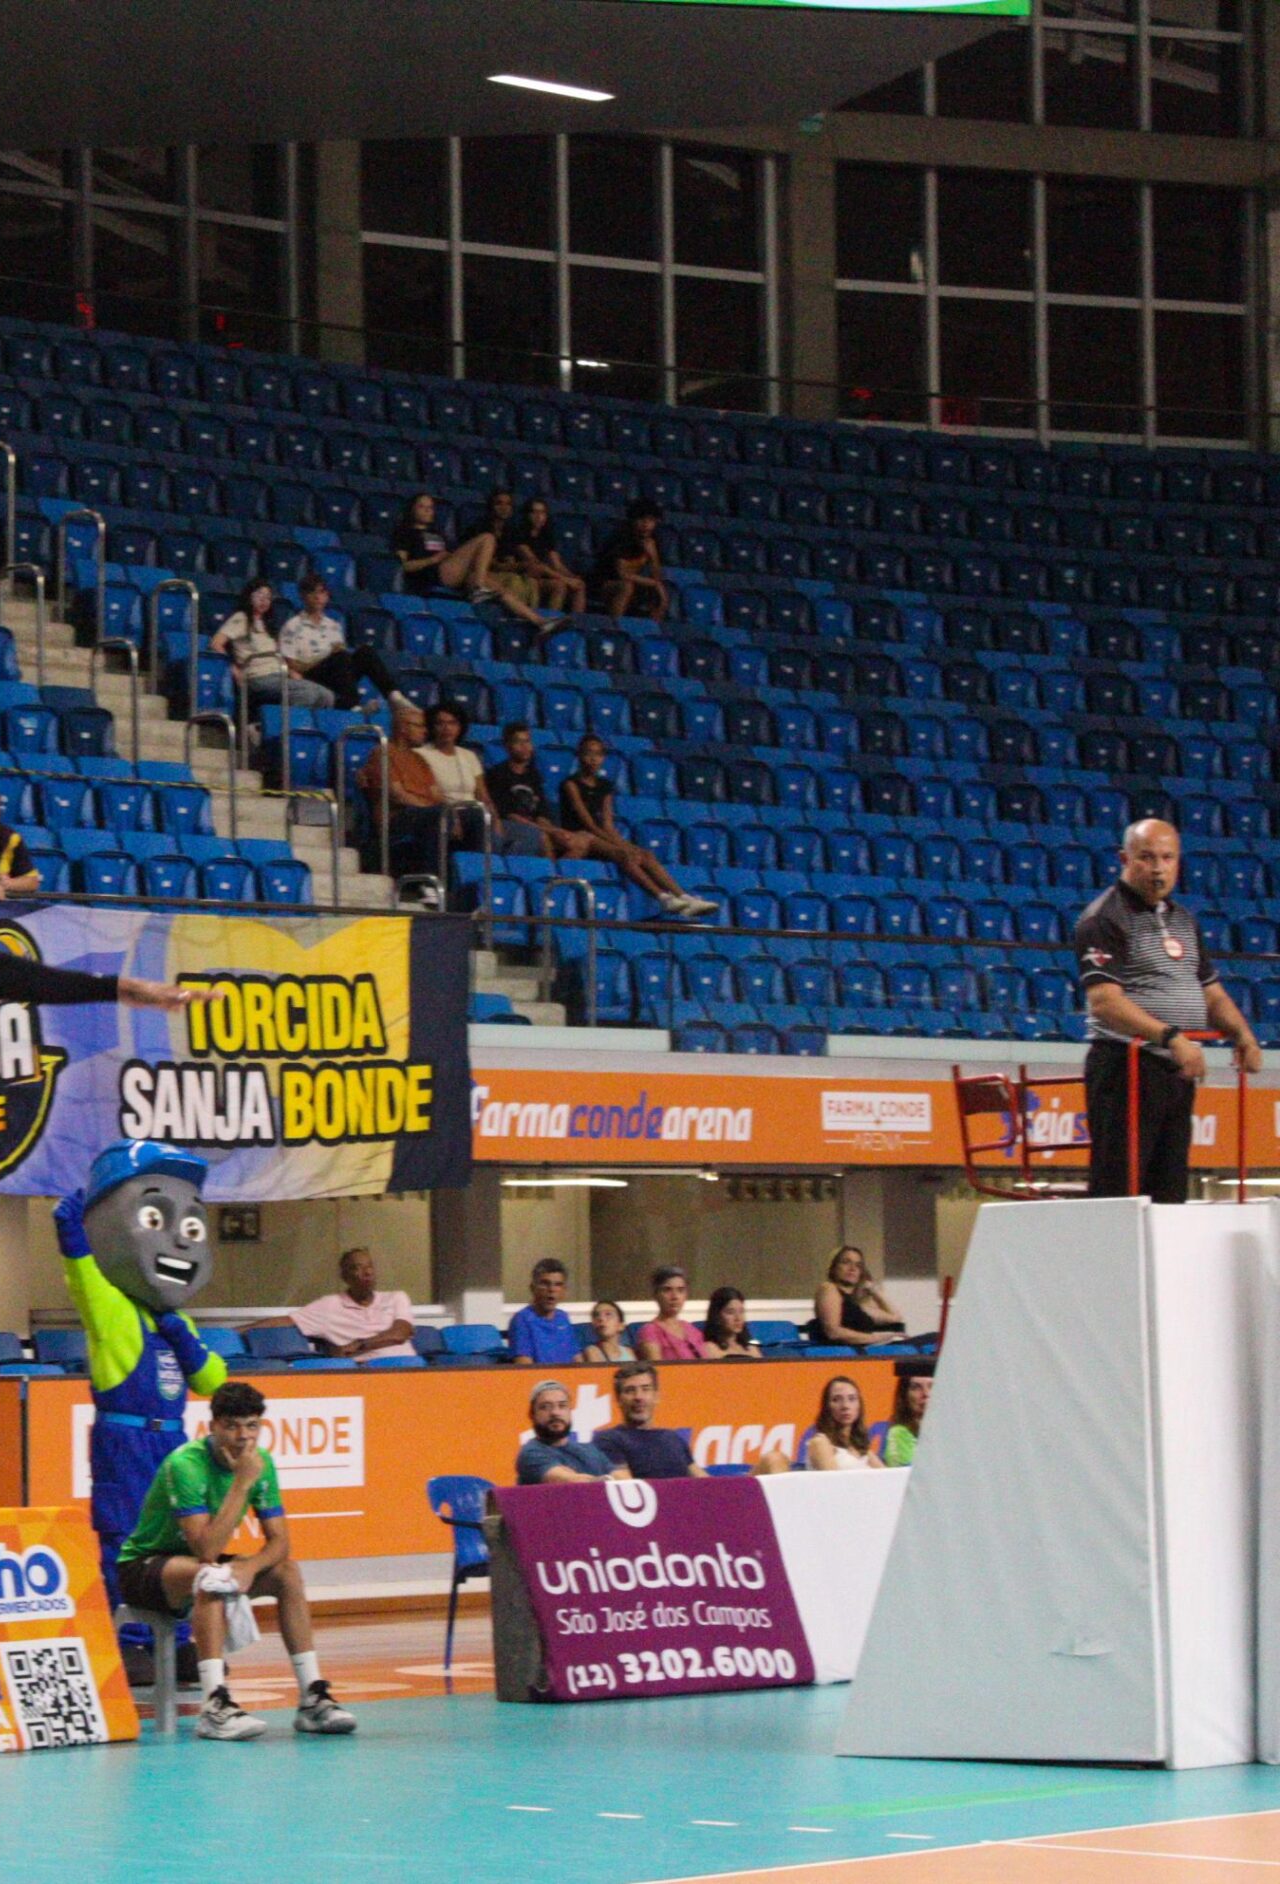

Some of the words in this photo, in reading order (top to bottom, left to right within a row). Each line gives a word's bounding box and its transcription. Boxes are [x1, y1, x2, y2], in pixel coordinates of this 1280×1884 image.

[178, 980, 386, 1052] TORCIDA
[122, 1066, 274, 1140] SANJA
[282, 1064, 433, 1140] BONDE
[827, 1099, 873, 1114] FARMA
[880, 1101, 926, 1117] CONDE
[536, 1541, 766, 1595] uniodonto
[557, 1608, 597, 1635] São
[602, 1602, 648, 1633] José
[653, 1602, 690, 1628] dos
[694, 1600, 772, 1633] Campos
[567, 1662, 617, 1695] (12)
[618, 1646, 797, 1684] 3202.6000
